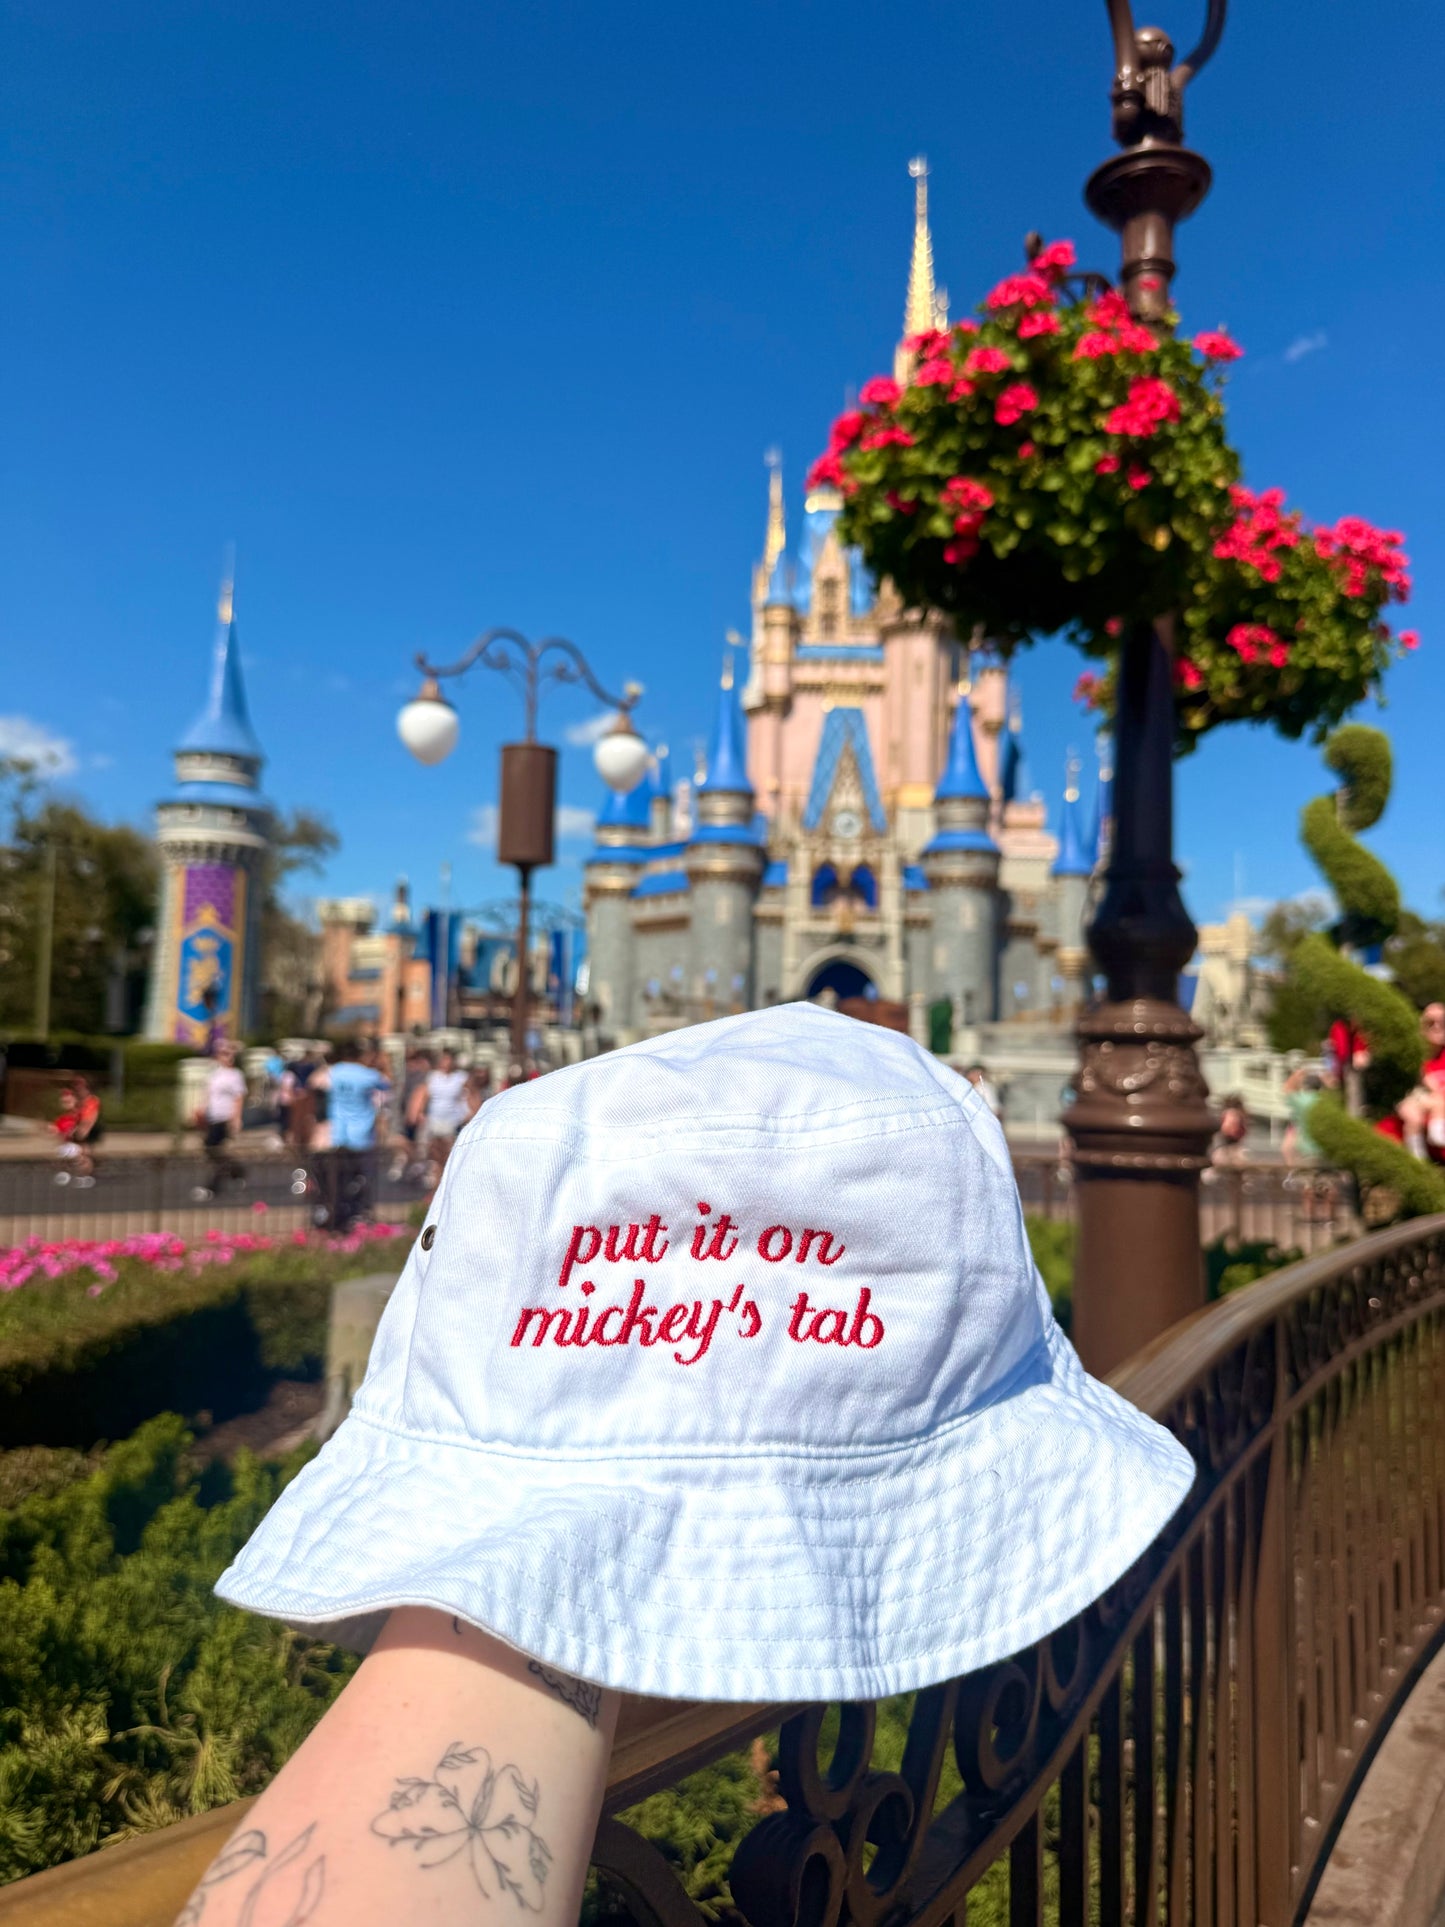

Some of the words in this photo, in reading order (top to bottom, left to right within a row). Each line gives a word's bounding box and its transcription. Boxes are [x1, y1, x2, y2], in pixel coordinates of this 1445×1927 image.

[558, 1213, 670, 1287] put
[690, 1201, 739, 1262] it
[757, 1224, 846, 1266] on
[510, 1279, 763, 1366] mickey's
[787, 1287, 885, 1349] tab
